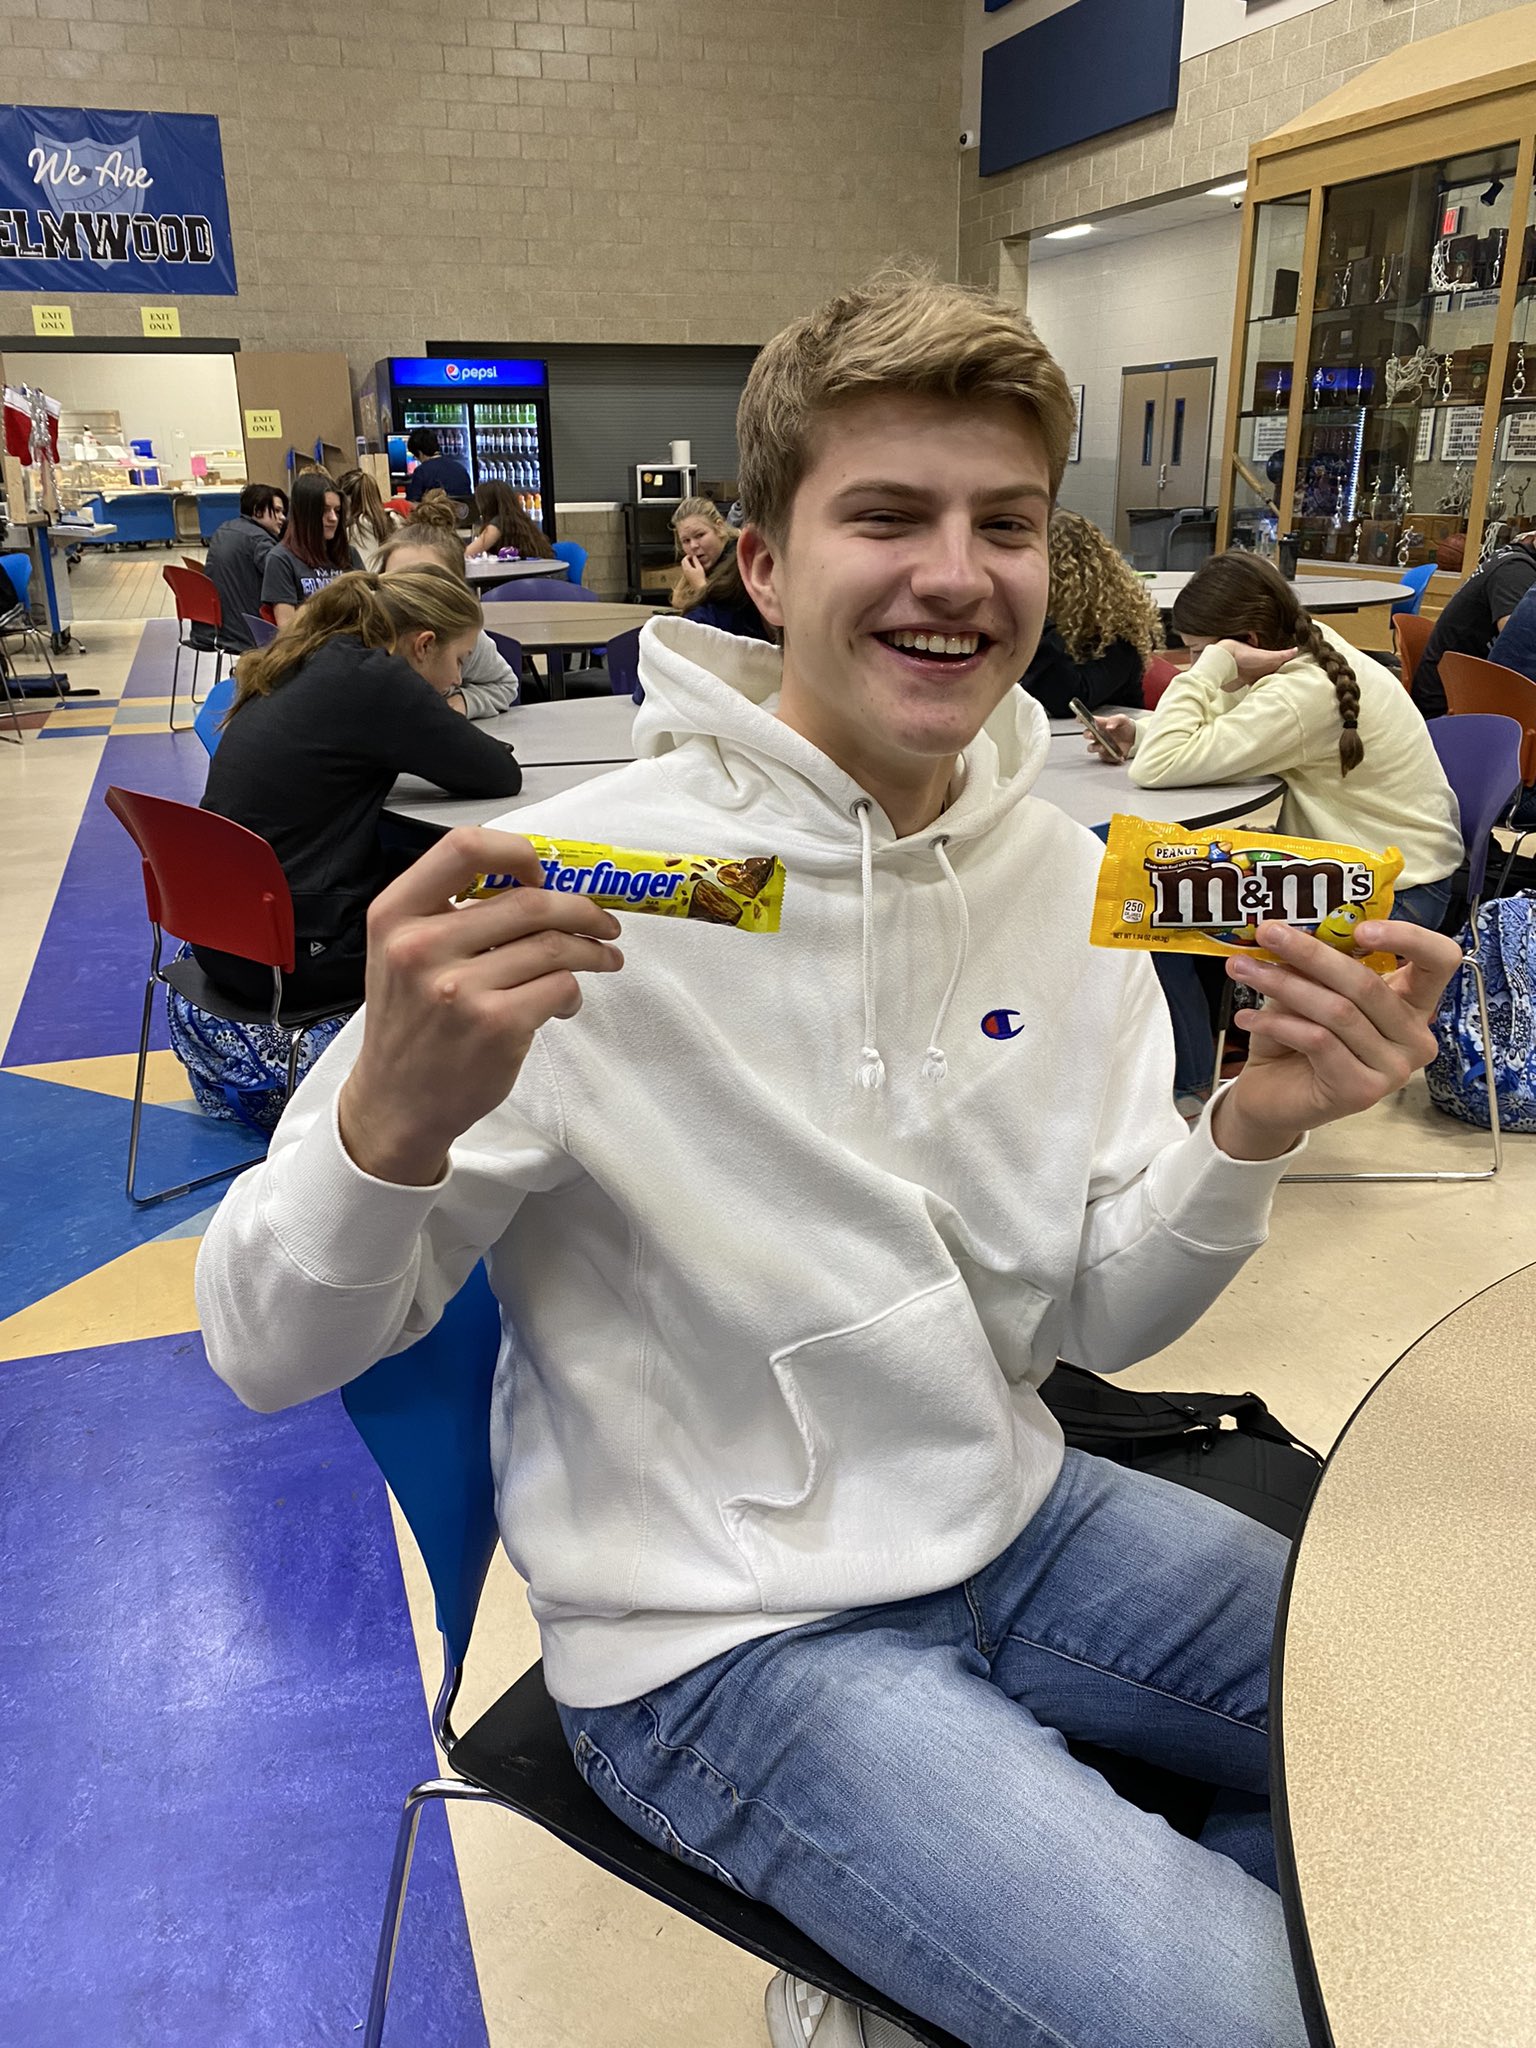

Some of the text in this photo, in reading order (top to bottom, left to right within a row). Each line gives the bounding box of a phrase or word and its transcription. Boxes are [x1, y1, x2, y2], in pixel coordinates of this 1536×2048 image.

[28, 147, 153, 188] We Are
[41, 312, 62, 320] EXIT
[150, 313, 170, 321] EXIT
[41, 321, 65, 330] ONLY
[149, 322, 173, 331] ONLY
[462, 365, 498, 380] pepsi
[253, 415, 272, 423] EXIT
[252, 424, 276, 432] ONLY
[1156, 846, 1199, 859] PEANUT
[483, 859, 685, 903] terfinger
[1126, 901, 1143, 913] 250
